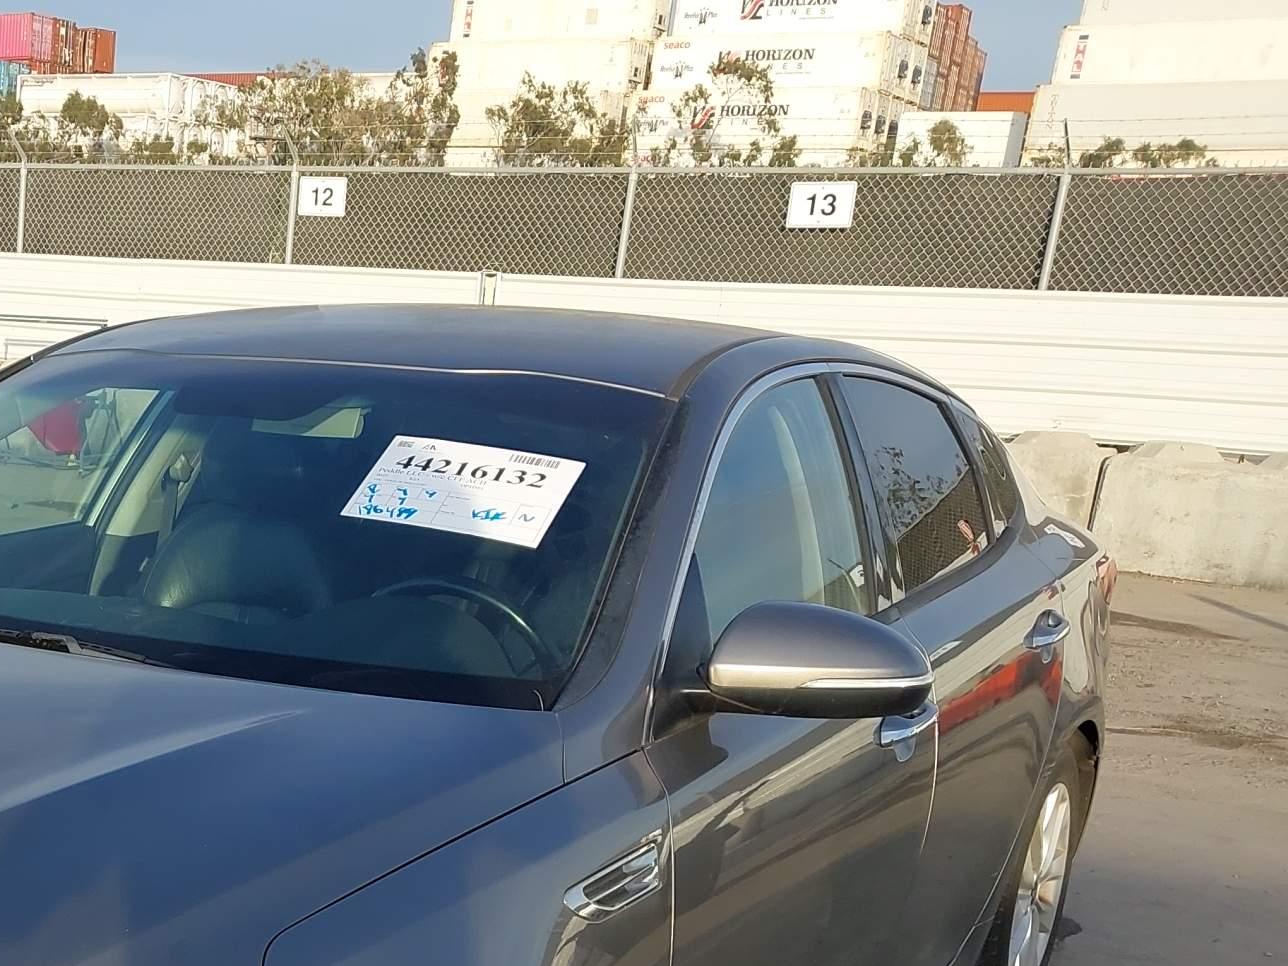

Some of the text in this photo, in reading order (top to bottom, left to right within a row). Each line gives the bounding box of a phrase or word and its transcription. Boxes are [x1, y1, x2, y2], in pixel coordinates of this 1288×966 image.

[766, 8, 827, 17] LINES
[663, 41, 691, 50] seaco
[744, 49, 816, 62] HORIZON
[719, 104, 791, 117] HORIZON
[311, 187, 334, 206] 12
[806, 193, 837, 216] 13
[395, 455, 548, 489] 44216132
